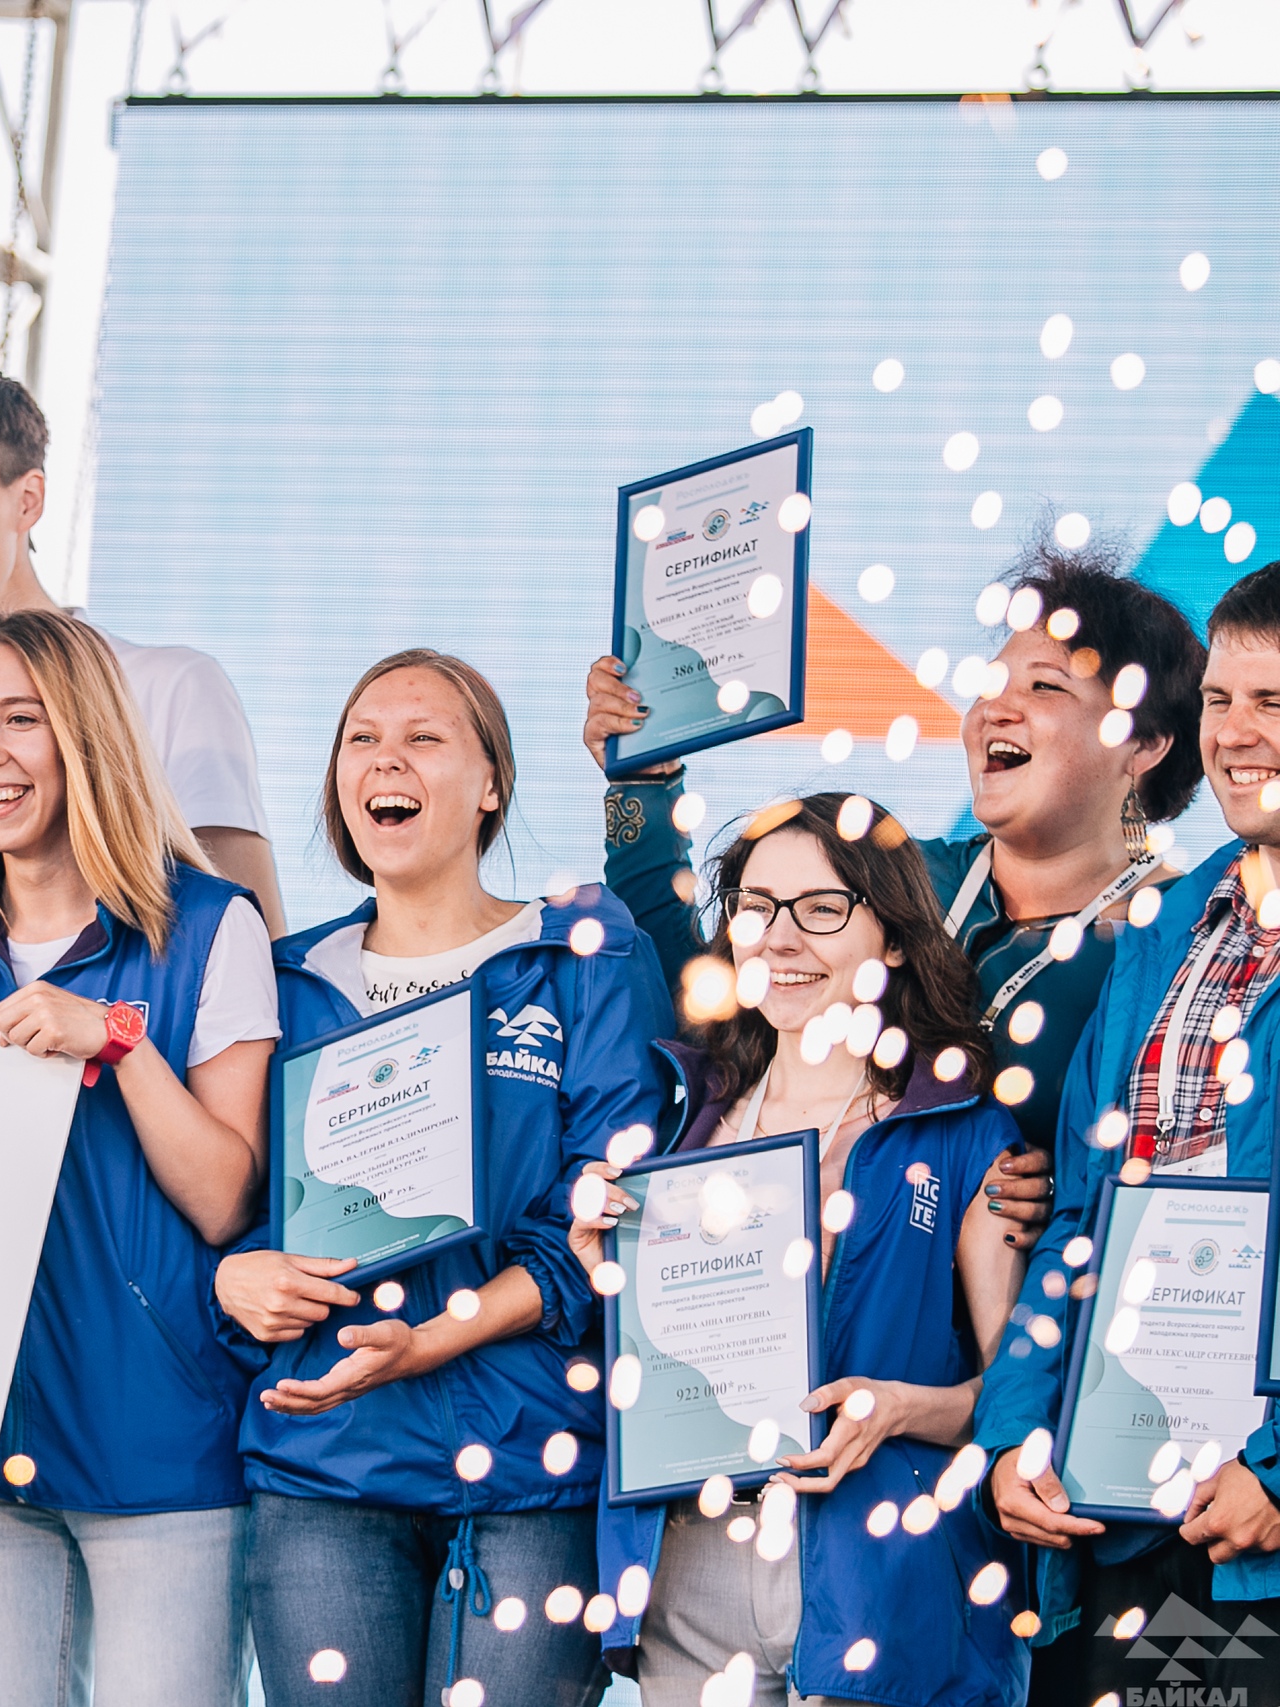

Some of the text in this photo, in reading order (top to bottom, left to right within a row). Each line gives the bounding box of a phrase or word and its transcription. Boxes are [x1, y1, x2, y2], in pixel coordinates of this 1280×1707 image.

[665, 538, 758, 577] СЕРТИФИКАТ
[672, 664, 694, 680] 386
[337, 1022, 419, 1058] Росмолодежь
[328, 1079, 431, 1128] СЕРТИФИКАТ
[303, 1115, 460, 1179] ИВАНОВА ВАЛЕРИЯ ВЛАДИМИРОВНА
[343, 1202, 359, 1217] 82
[1166, 1200, 1249, 1214] Росмолодежь
[661, 1250, 764, 1281] СЕРТИФИКАТ
[651, 1282, 770, 1308] претендента Всероссийского конкурса
[717, 1296, 745, 1306] проектов
[660, 1310, 771, 1336] ДЁМИНА АННА ИГОРЕВНА
[1167, 1321, 1215, 1330] Всероссийского
[1150, 1330, 1188, 1338] молодежных
[647, 1333, 787, 1362] «РАЗРАБОТКА ПРОДУКТОВ ПИТАНИЯ
[726, 1349, 755, 1359] СЕМЯН
[1154, 1349, 1206, 1359] АЛЕКСАНДР
[676, 1386, 700, 1403] 922
[737, 1382, 757, 1392] РУБ.
[1140, 1385, 1214, 1396] «ЗЕЛЕНАЯ ХИМИЯ»
[1130, 1413, 1154, 1427] 150
[1190, 1422, 1210, 1431] РУБ.
